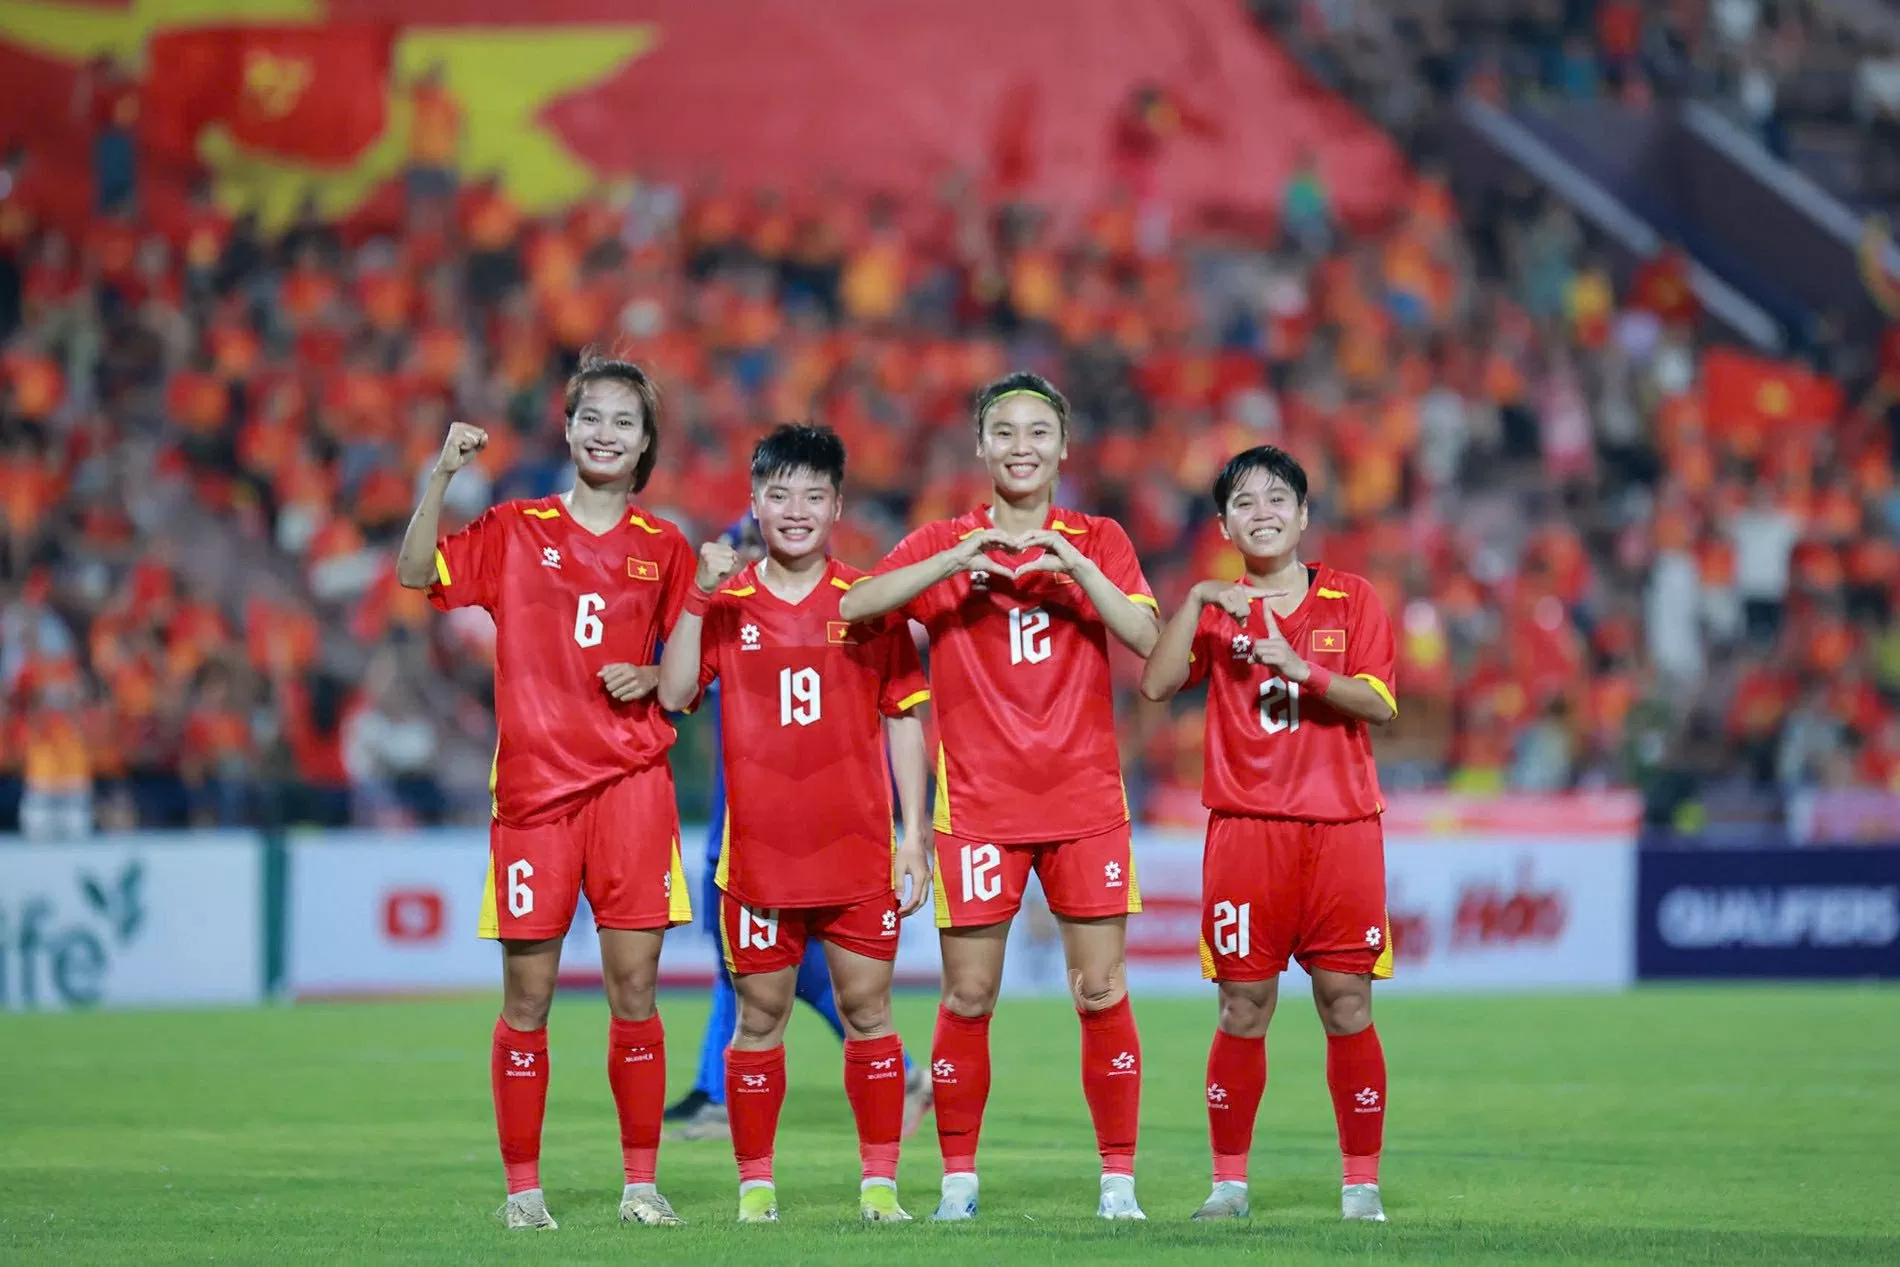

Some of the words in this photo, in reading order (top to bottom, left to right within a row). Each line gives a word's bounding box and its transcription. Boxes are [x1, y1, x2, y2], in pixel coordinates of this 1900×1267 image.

[573, 592, 606, 649] 6
[1008, 606, 1052, 666] 12
[779, 667, 822, 727] 19
[1259, 676, 1301, 735] 21
[507, 858, 534, 919] 6
[960, 843, 1002, 903] 12
[739, 906, 779, 951] 19
[1214, 900, 1251, 959] 21
[1658, 885, 1900, 948] QUALIFIERS
